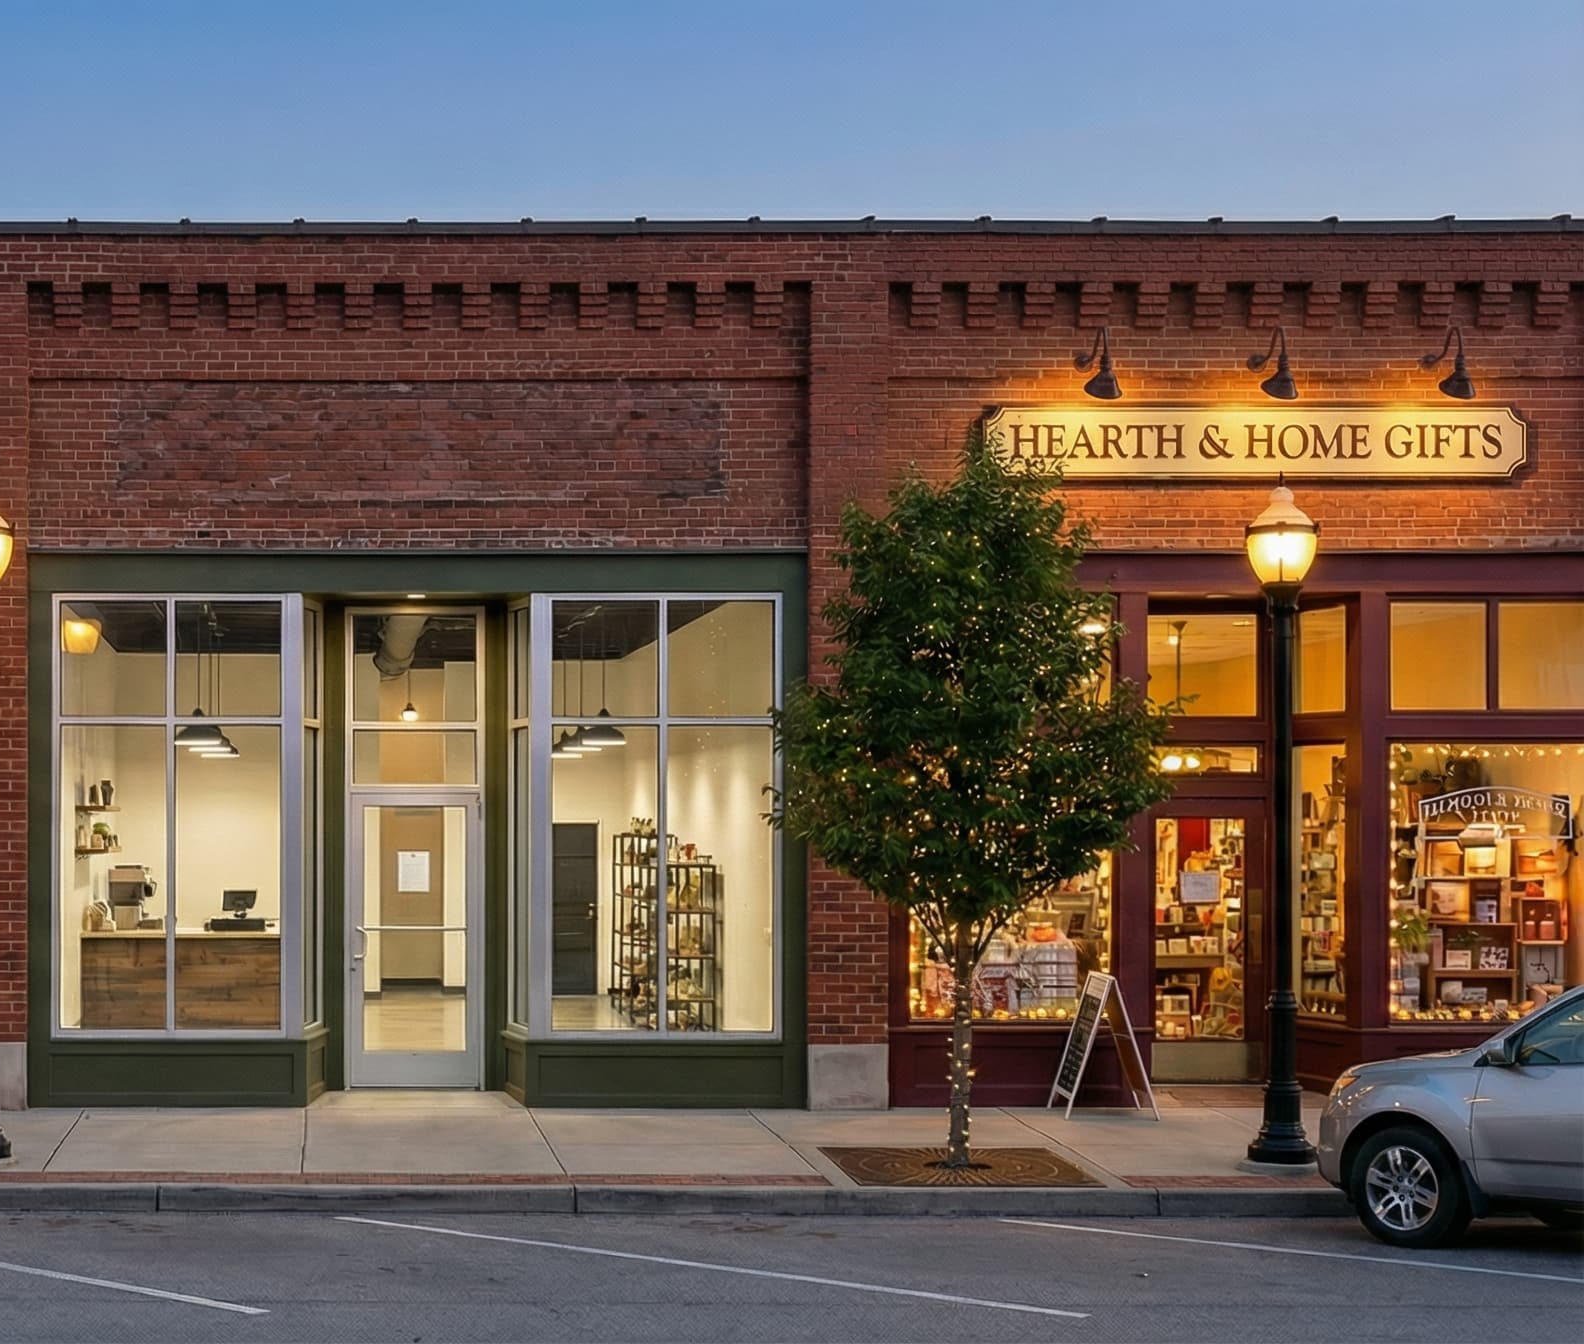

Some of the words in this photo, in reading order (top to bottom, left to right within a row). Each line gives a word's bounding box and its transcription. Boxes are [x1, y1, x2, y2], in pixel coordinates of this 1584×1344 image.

[1009, 423, 1186, 459] HEARTH
[1198, 423, 1234, 460] &
[1243, 423, 1372, 460] HOME
[1384, 423, 1503, 460] GIFTS
